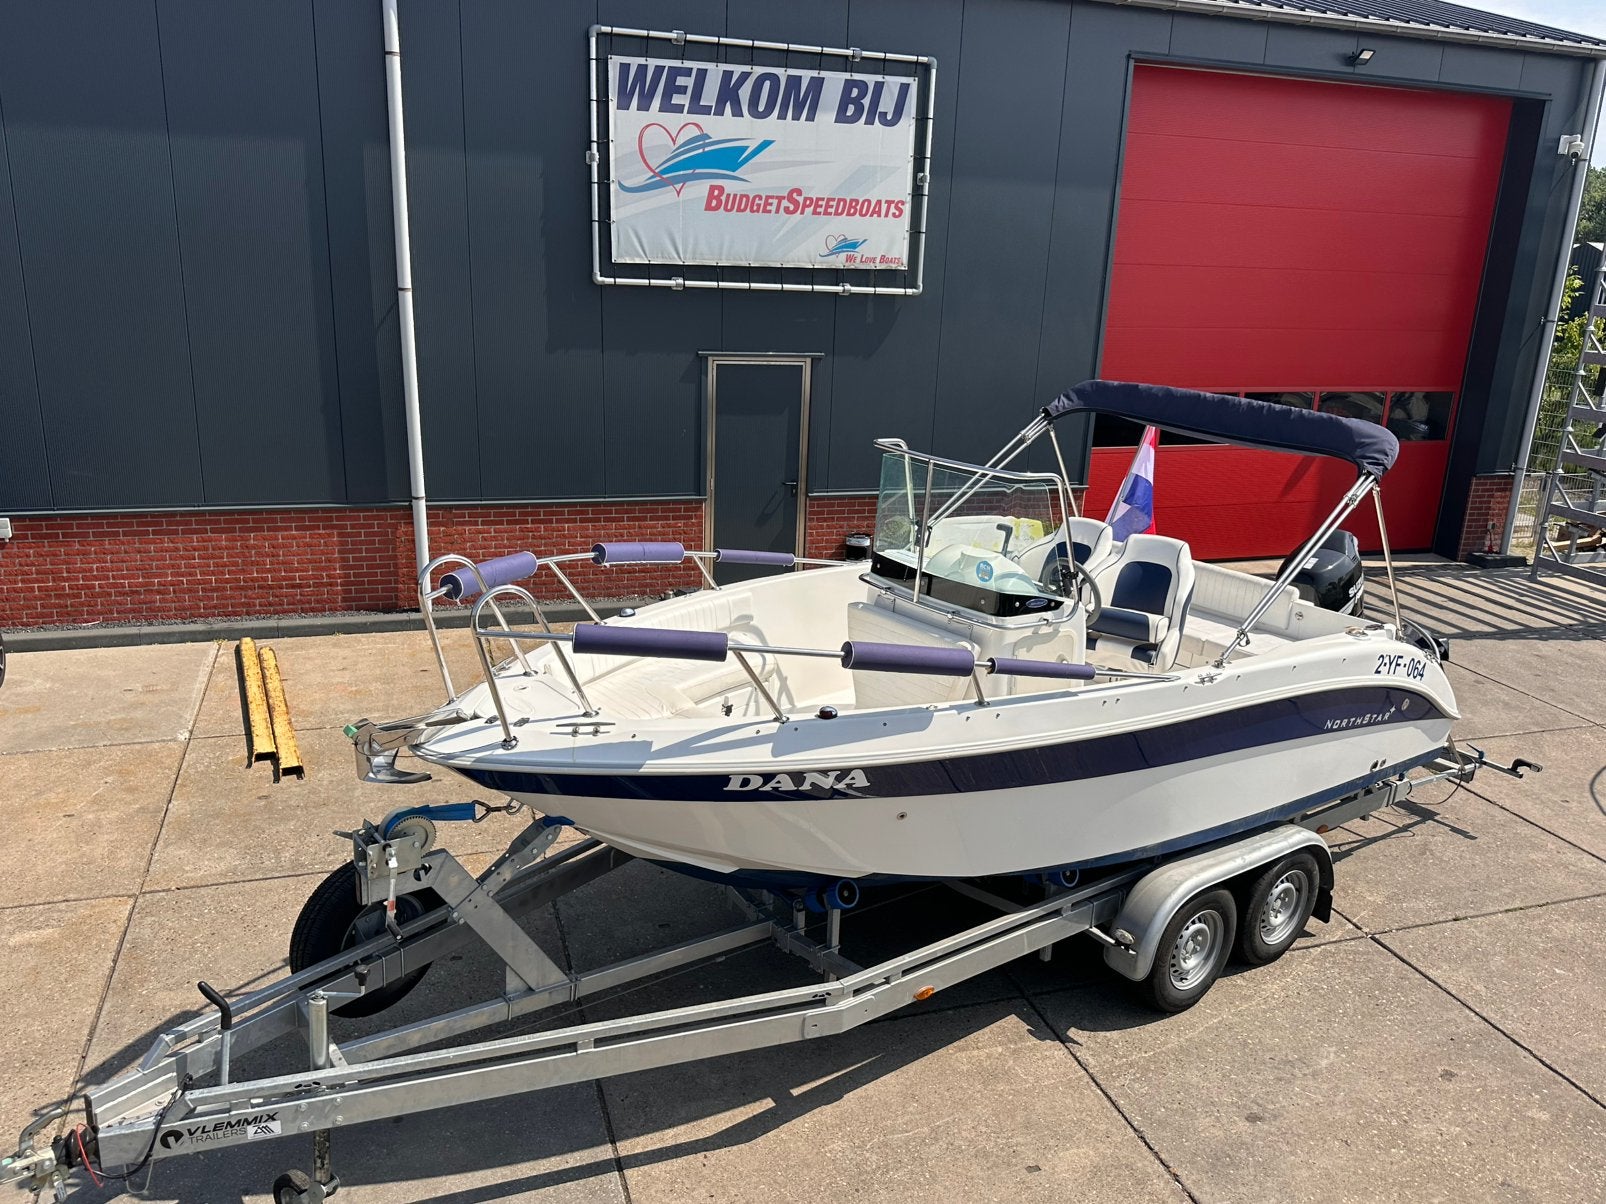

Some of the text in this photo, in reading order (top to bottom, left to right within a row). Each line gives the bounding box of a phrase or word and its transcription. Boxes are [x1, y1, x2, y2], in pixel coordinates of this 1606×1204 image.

[616, 62, 910, 127] WELKOM BIJ
[723, 768, 870, 791] DANA
[187, 1112, 279, 1136] VLEMMIX
[189, 1127, 247, 1145] TRAILERS
